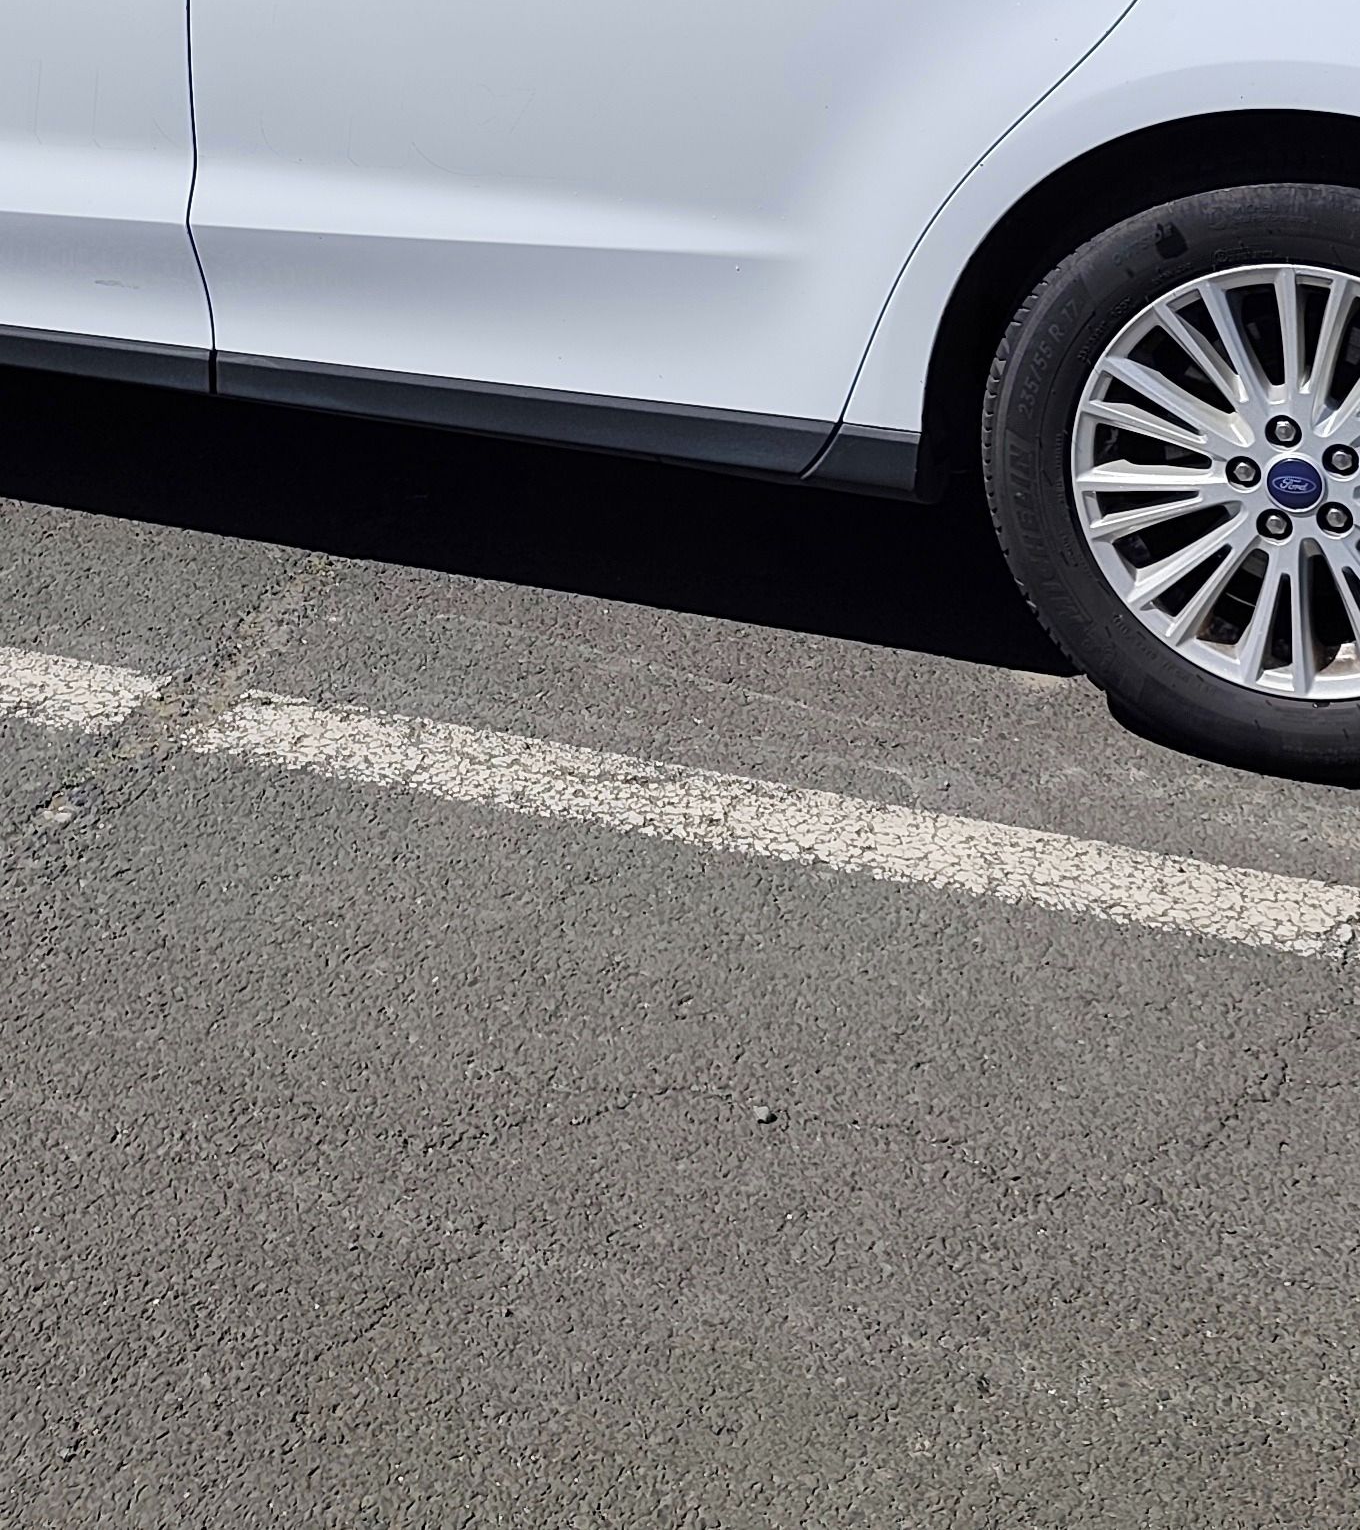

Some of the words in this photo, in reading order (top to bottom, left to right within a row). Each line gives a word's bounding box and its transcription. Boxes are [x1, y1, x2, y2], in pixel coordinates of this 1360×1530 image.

[1018, 340, 1052, 420] 235/55
[1048, 323, 1065, 343] R
[1060, 298, 1079, 323] 17
[1279, 477, 1309, 491] Ford
